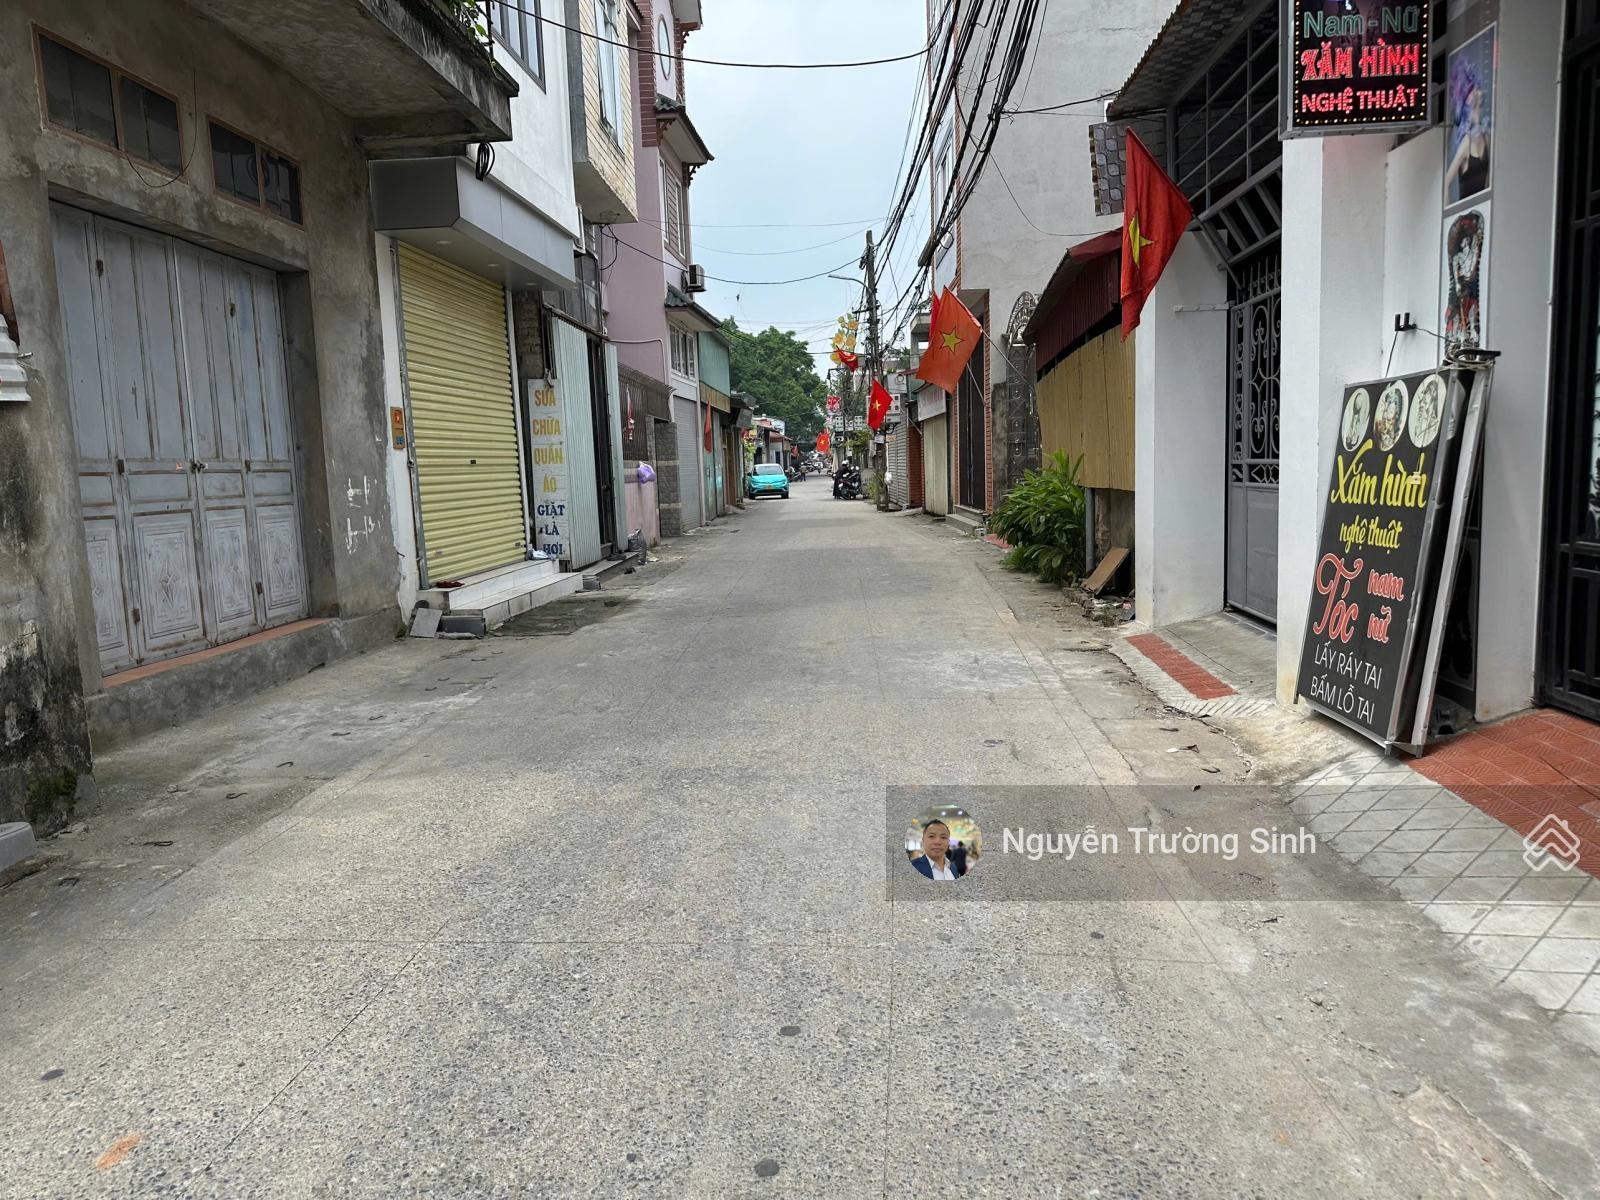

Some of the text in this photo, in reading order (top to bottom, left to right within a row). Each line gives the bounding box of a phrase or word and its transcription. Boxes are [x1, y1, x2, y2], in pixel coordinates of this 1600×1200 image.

[1300, 37, 1420, 81] XĂM HÌNH
[1301, 83, 1419, 114] NGHỆ THUẬT
[532, 415, 561, 436] CHỮA
[543, 473, 557, 493] ÁO
[1331, 438, 1377, 506] Xăm
[537, 501, 565, 519] GIẶT
[545, 521, 560, 536] LÀ
[1339, 514, 1403, 555] nghệ thuật
[543, 541, 563, 555] HƠI
[1312, 552, 1364, 644] Tóc
[1367, 568, 1405, 602] nam
[1366, 605, 1393, 644] nữ
[1315, 640, 1383, 690] LẤY RÁY TAI
[1310, 673, 1375, 725] BẤM LỖ TAI
